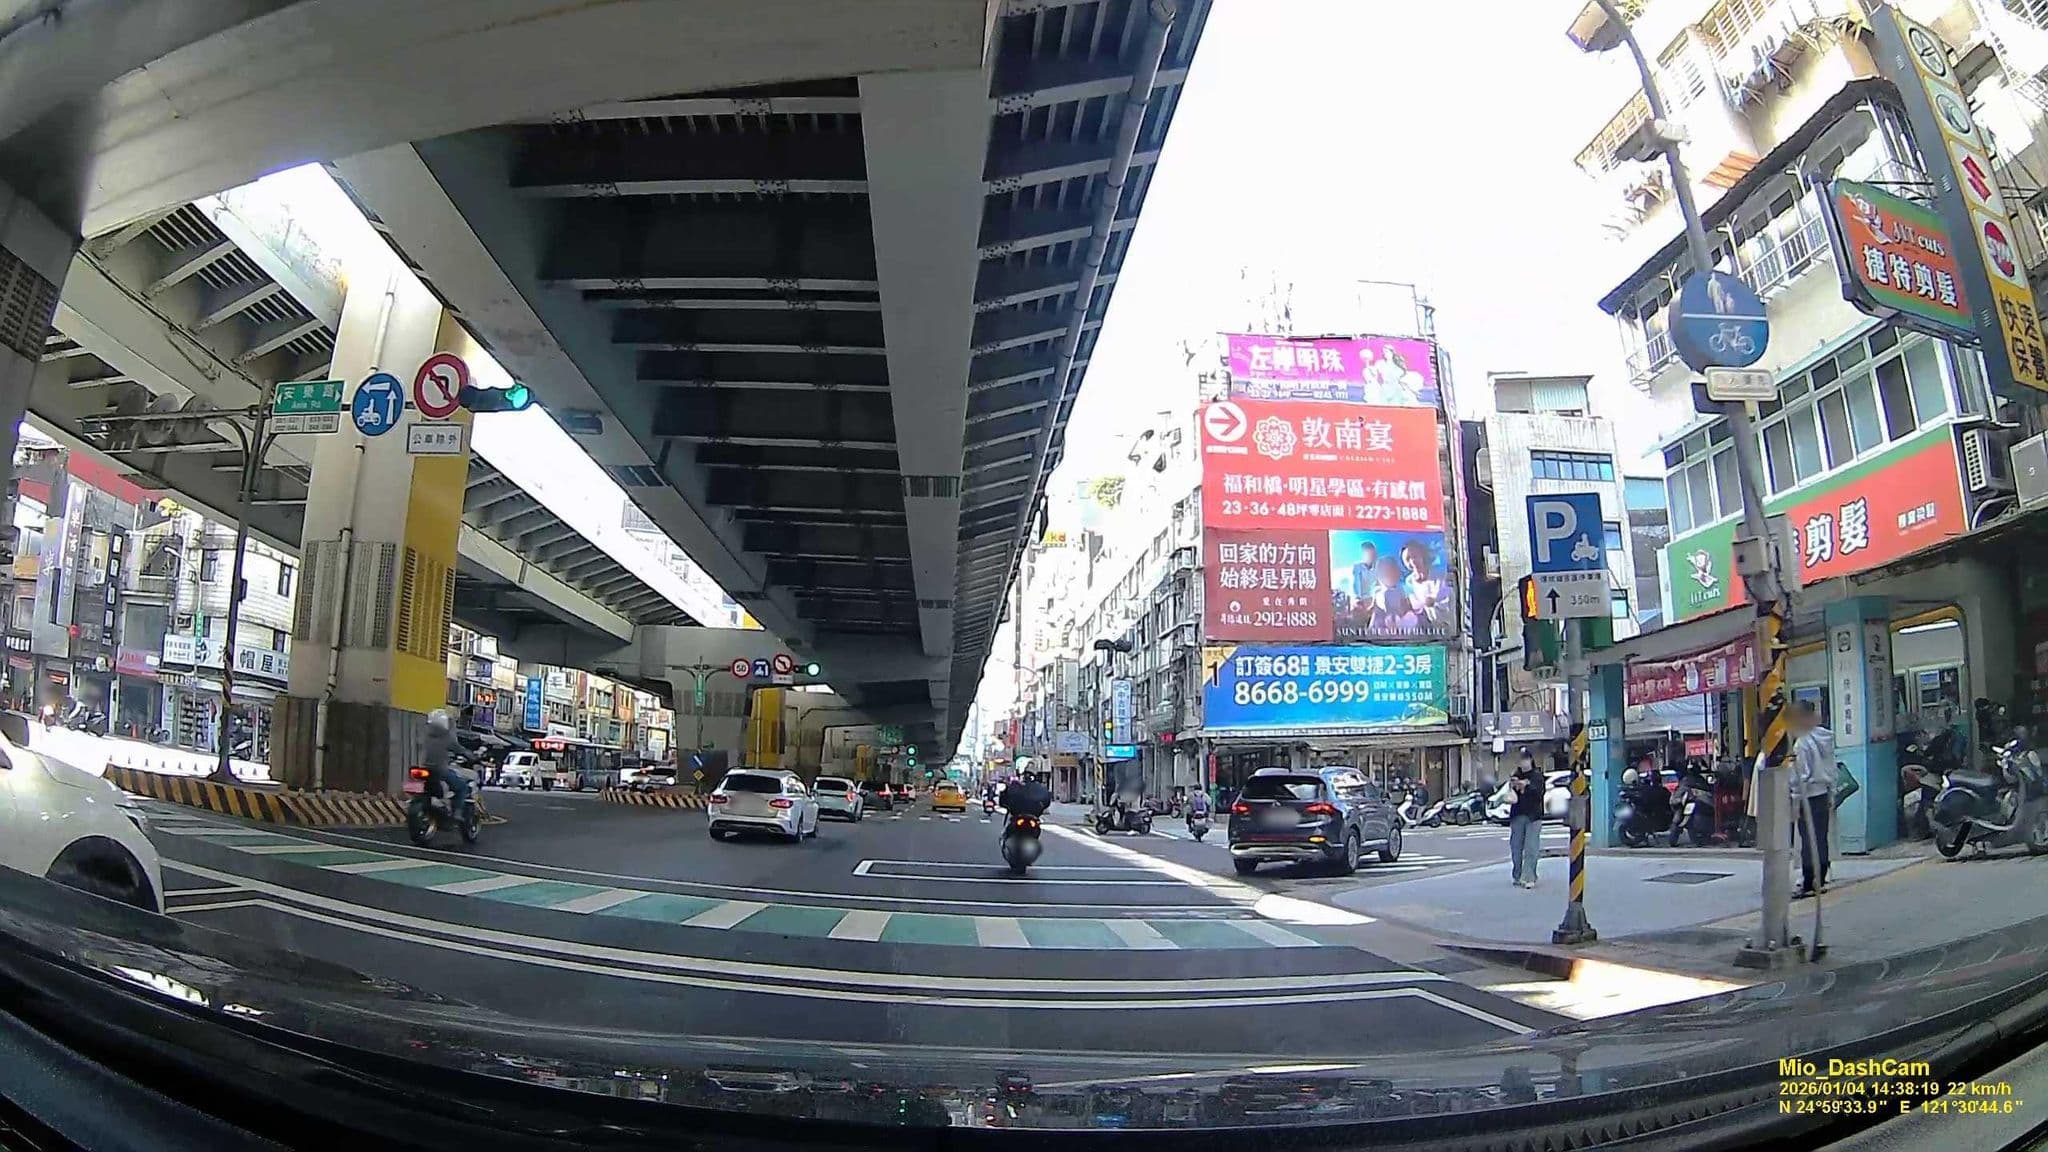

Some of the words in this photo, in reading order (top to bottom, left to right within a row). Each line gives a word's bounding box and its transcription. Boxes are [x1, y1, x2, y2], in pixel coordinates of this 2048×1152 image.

[1863, 244, 1958, 308] 捷特剪髮
[1356, 504, 1428, 521] 2273-1888
[1533, 501, 1577, 563] P
[1793, 497, 1869, 568] 剪髮
[1219, 542, 1316, 565] 回家的方向
[1219, 566, 1317, 590] 始終是昇陽
[1234, 680, 1369, 705] 8668-6999
